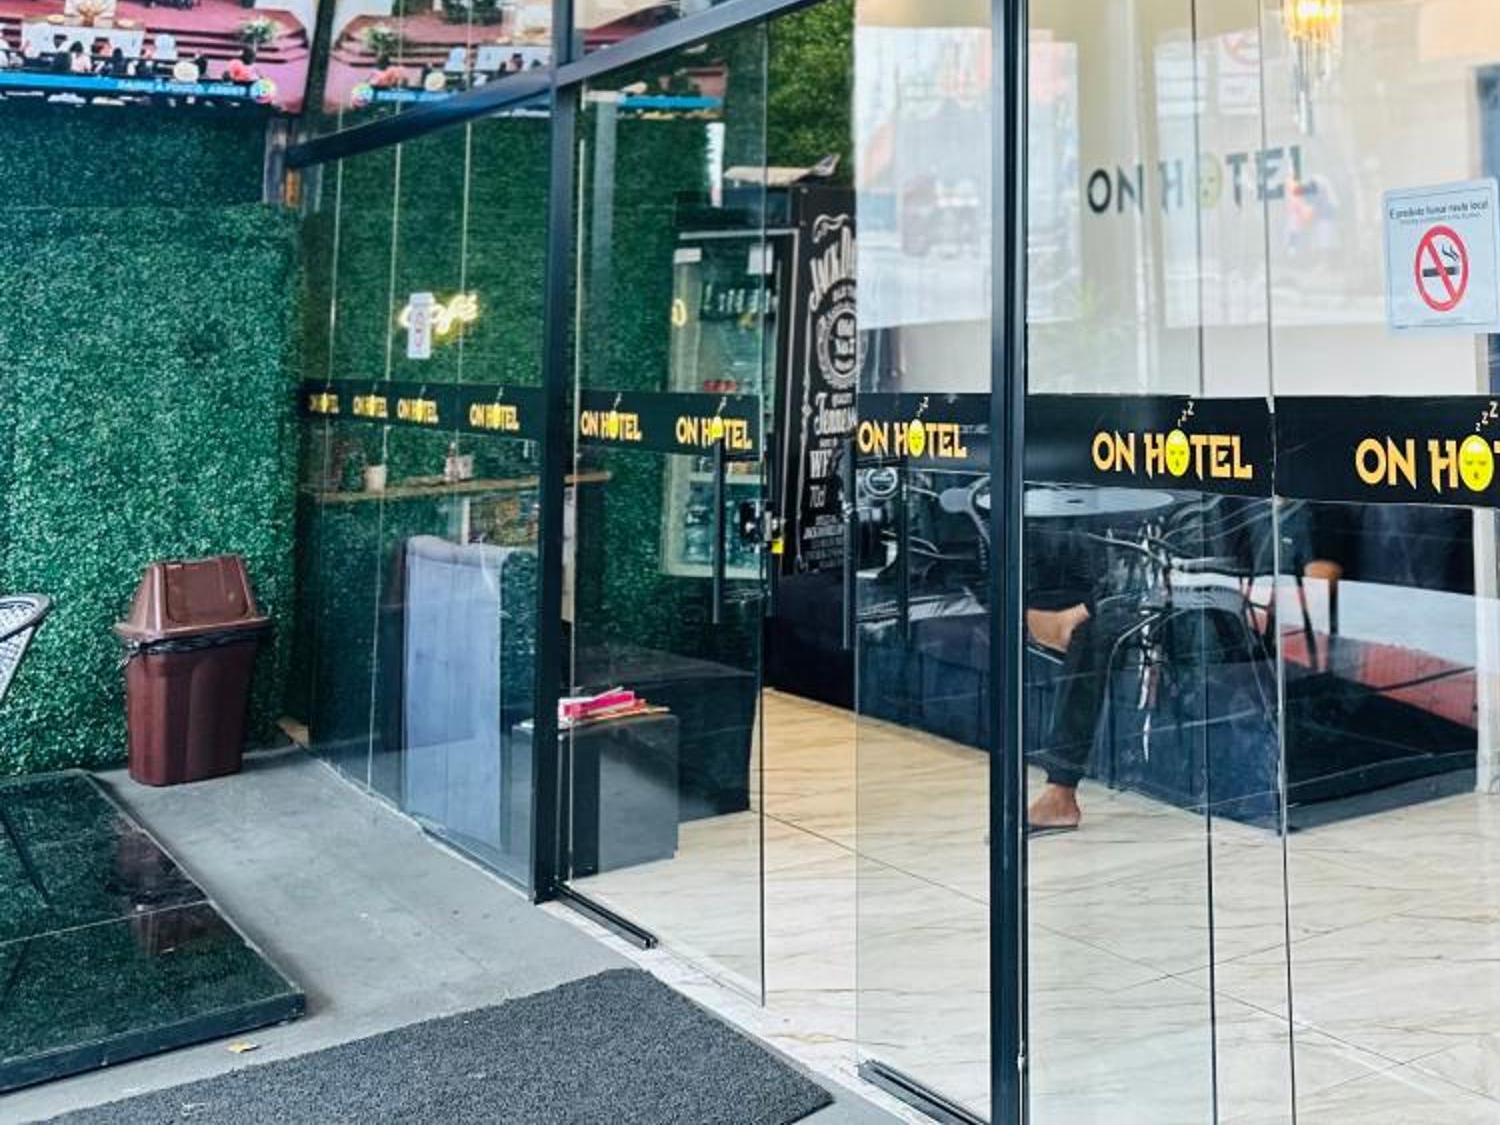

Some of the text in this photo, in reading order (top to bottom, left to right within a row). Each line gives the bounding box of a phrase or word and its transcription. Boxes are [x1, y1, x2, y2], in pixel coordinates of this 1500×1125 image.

[1088, 144, 1318, 216] ON HOTEL
[580, 410, 599, 437] ON
[676, 415, 699, 445] ON
[859, 418, 967, 460] ON HOTEL
[1092, 429, 1253, 481] ON HOTEL
[1355, 435, 1417, 490] ON
